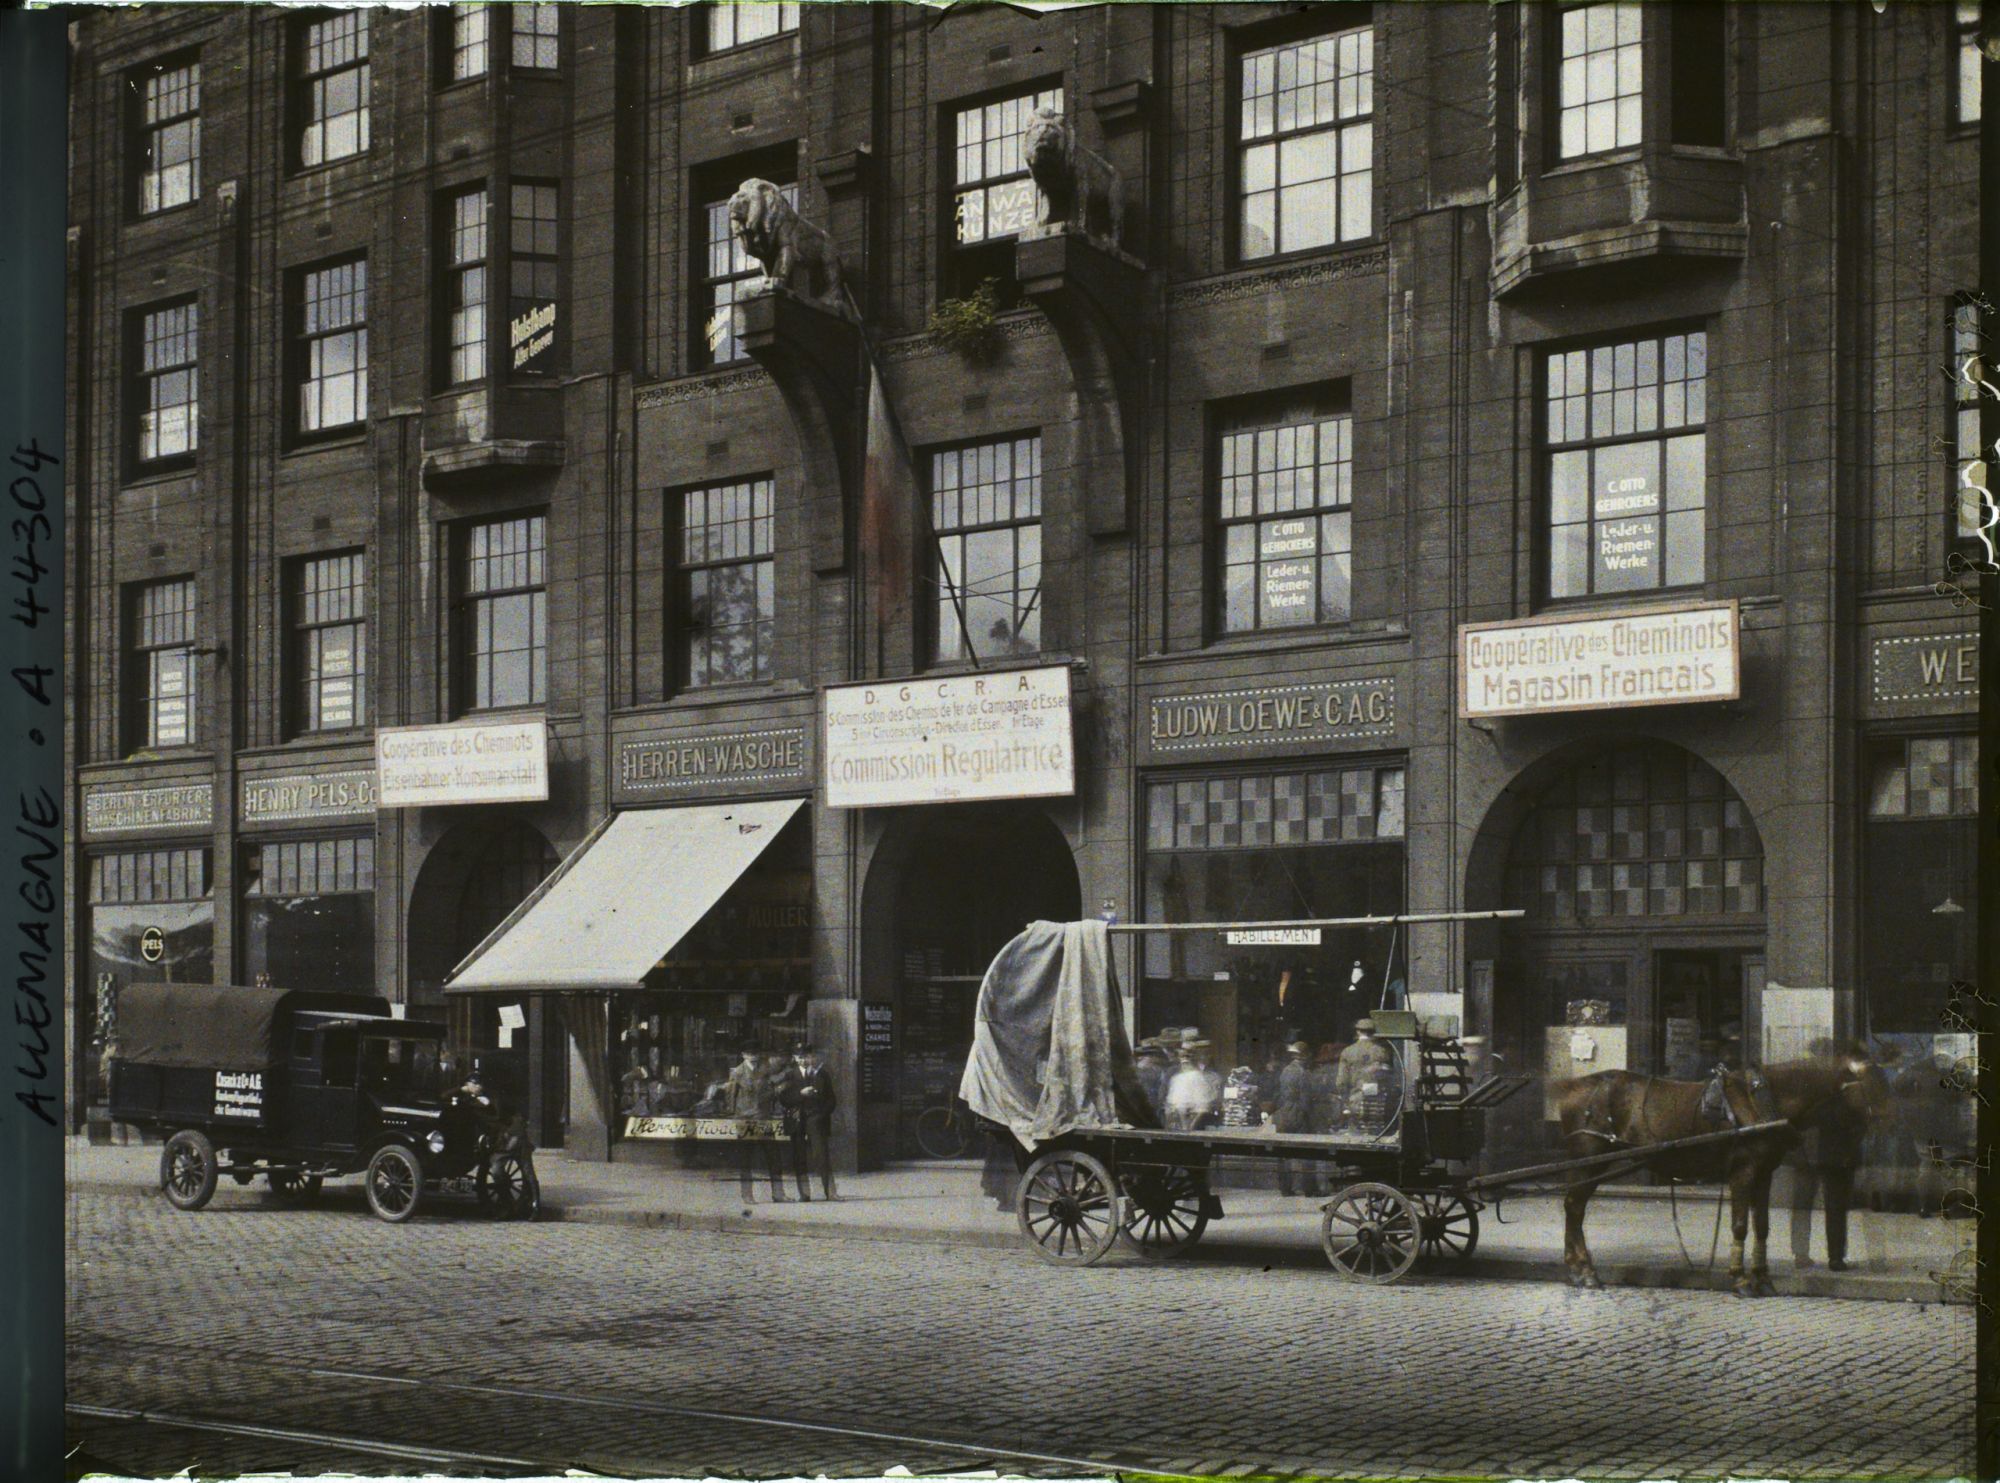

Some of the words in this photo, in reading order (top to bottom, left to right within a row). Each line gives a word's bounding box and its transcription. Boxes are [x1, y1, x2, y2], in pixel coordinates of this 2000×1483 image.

[1619, 477, 1646, 492] OTTO
[9, 438, 60, 629] 44304
[1281, 521, 1305, 535] OTTO
[1601, 539, 1655, 555] Riemen-
[1267, 563, 1301, 578] Leder-
[1604, 553, 1648, 570] Werke
[1266, 579, 1312, 594] Riemen-
[1269, 593, 1306, 608] Werke
[1470, 629, 1586, 671] Coopérative
[1612, 615, 1729, 657] Cheminots
[11, 665, 54, 706] A
[1483, 667, 1592, 707] Magasin
[1600, 657, 1716, 697] Français
[1154, 705, 1222, 739] LUDW.
[1227, 695, 1312, 734] LOEWE
[450, 732, 472, 756] des
[829, 746, 937, 785] Commission
[246, 784, 303, 813] HENRY
[308, 780, 350, 807] PELS
[1233, 928, 1316, 943] HABILLEMENT
[14, 786, 60, 1127] ALLEMAGNE
